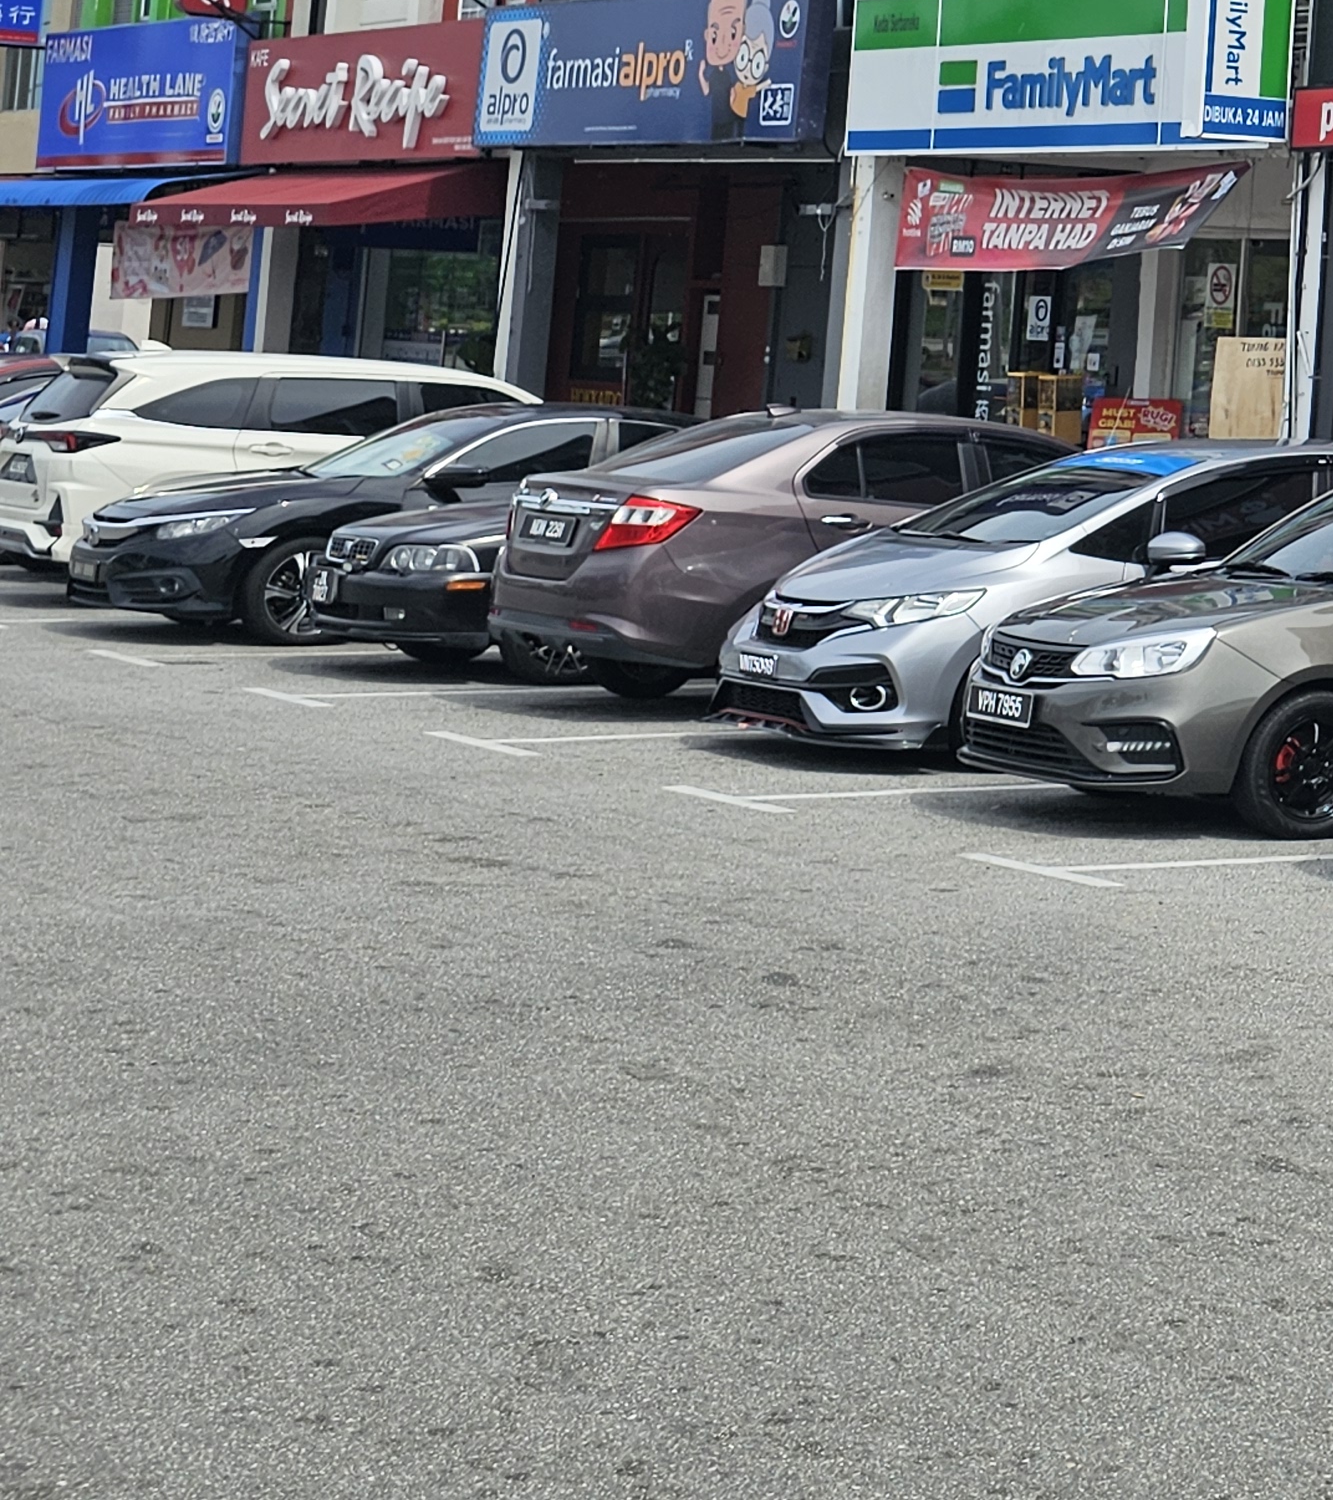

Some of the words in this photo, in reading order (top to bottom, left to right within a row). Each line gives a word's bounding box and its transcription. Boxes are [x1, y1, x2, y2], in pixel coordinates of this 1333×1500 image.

[46, 34, 93, 64] FARMASI
[250, 49, 270, 67] KAFE
[109, 73, 161, 100] HEALTH
[165, 72, 202, 97] LANE
[985, 55, 1157, 117] FamilyMart
[144, 102, 198, 117] PHARMACY
[260, 58, 349, 140] Secret
[349, 54, 450, 149] Recipe
[487, 86, 530, 126] alpro
[1204, 104, 1243, 126] DIBUKA
[1246, 107, 1260, 125] 24
[1261, 110, 1285, 129] JAM
[989, 187, 1110, 219] INTERNET
[981, 222, 1049, 251] TANPA
[1049, 221, 1098, 251] HAD
[976, 280, 1000, 392] farmasi
[978, 690, 998, 716] VPH
[999, 693, 1025, 720] 7955
